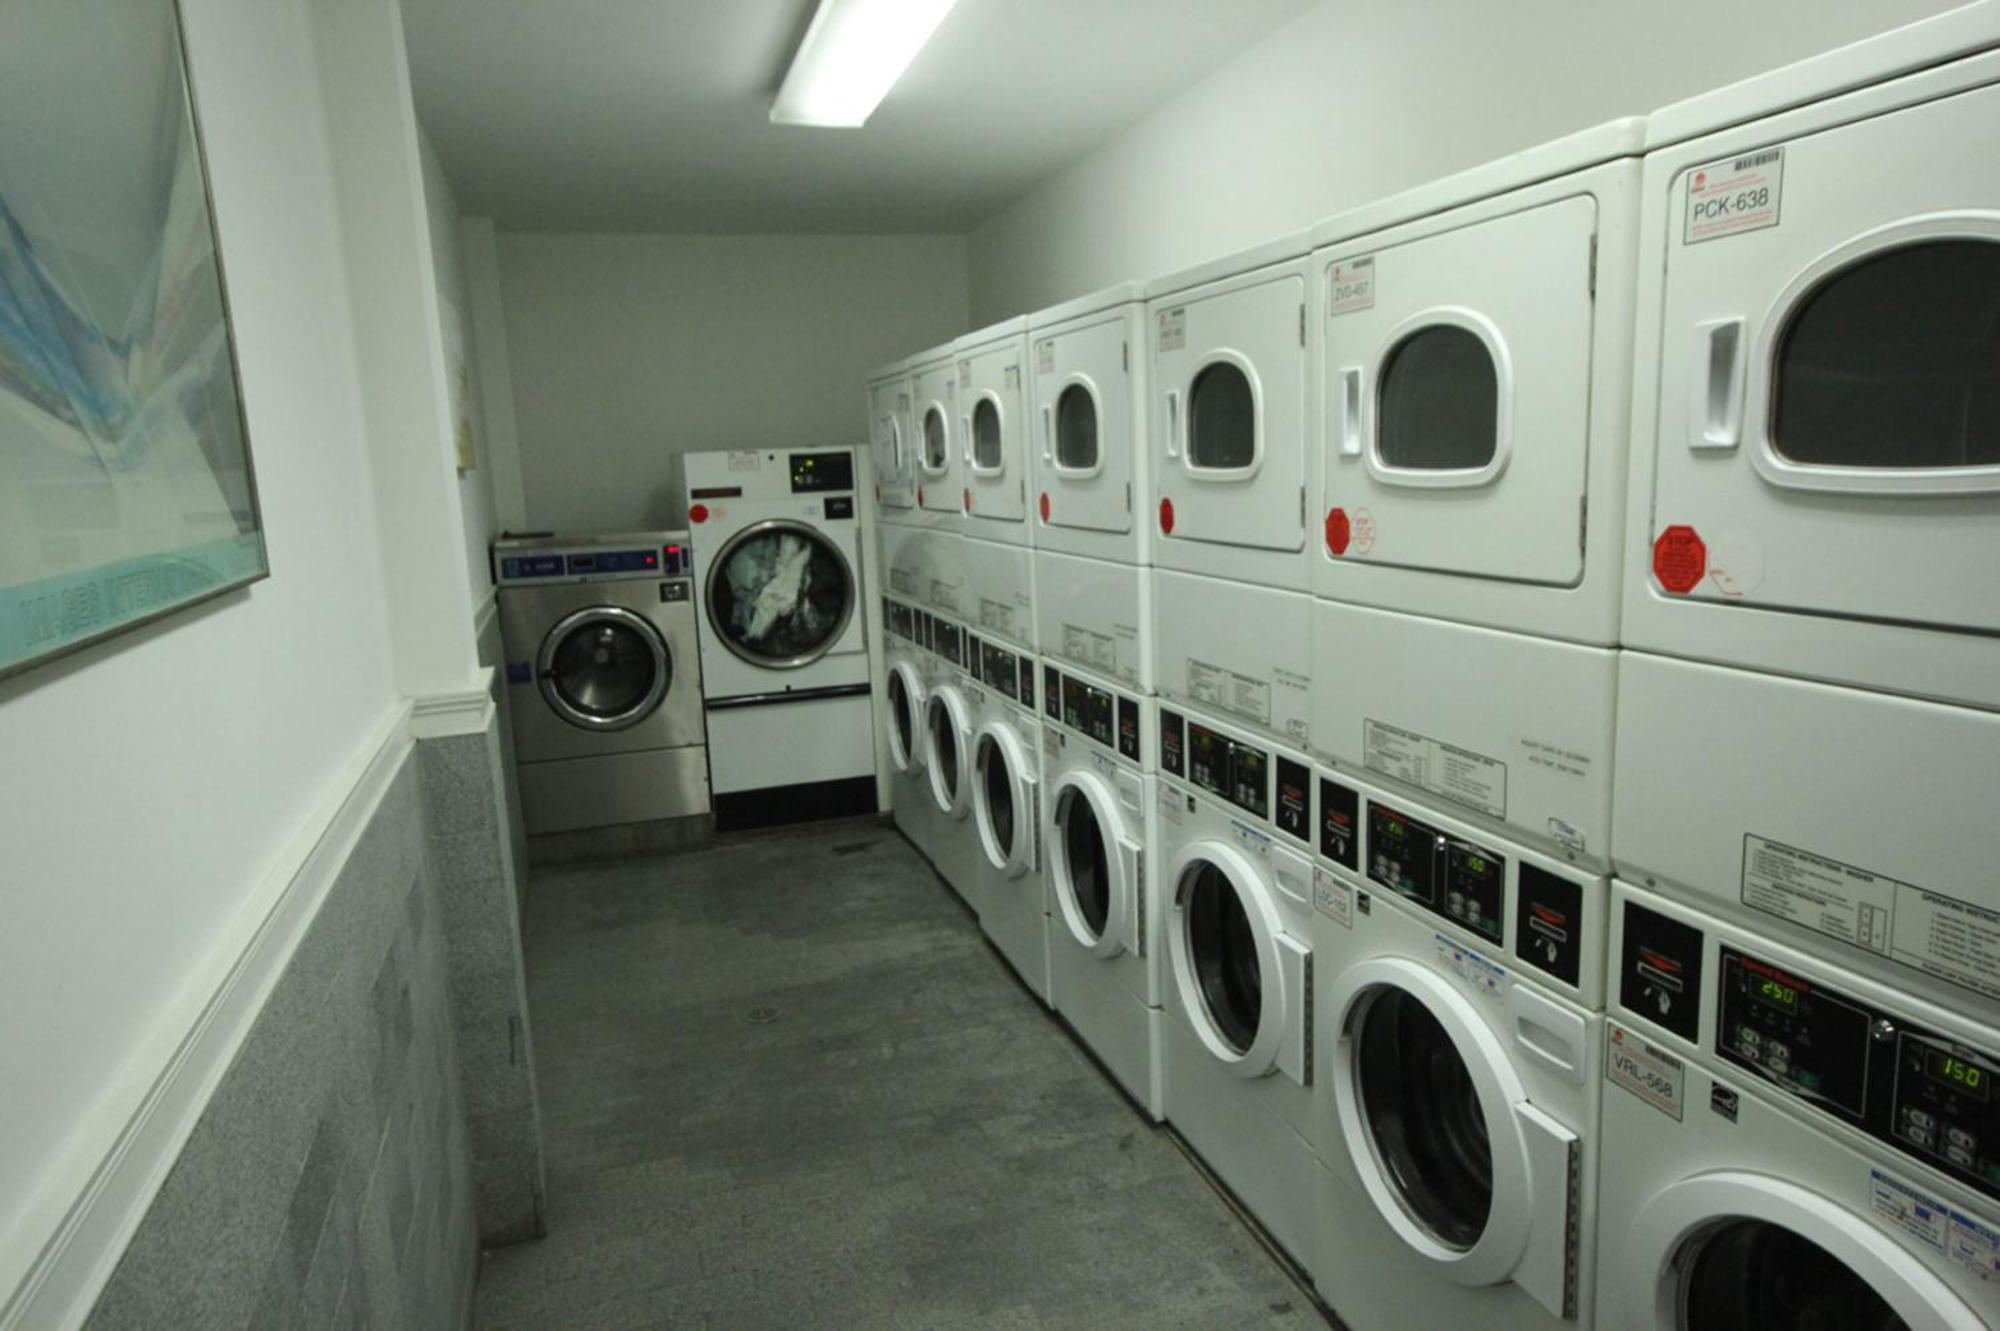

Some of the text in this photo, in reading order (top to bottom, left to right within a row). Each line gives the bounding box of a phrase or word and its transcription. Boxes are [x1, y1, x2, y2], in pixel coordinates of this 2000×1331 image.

[1693, 187, 1769, 221] PCK-638
[1760, 981, 1794, 1004] 250
[1944, 1058, 1981, 1087] 150
